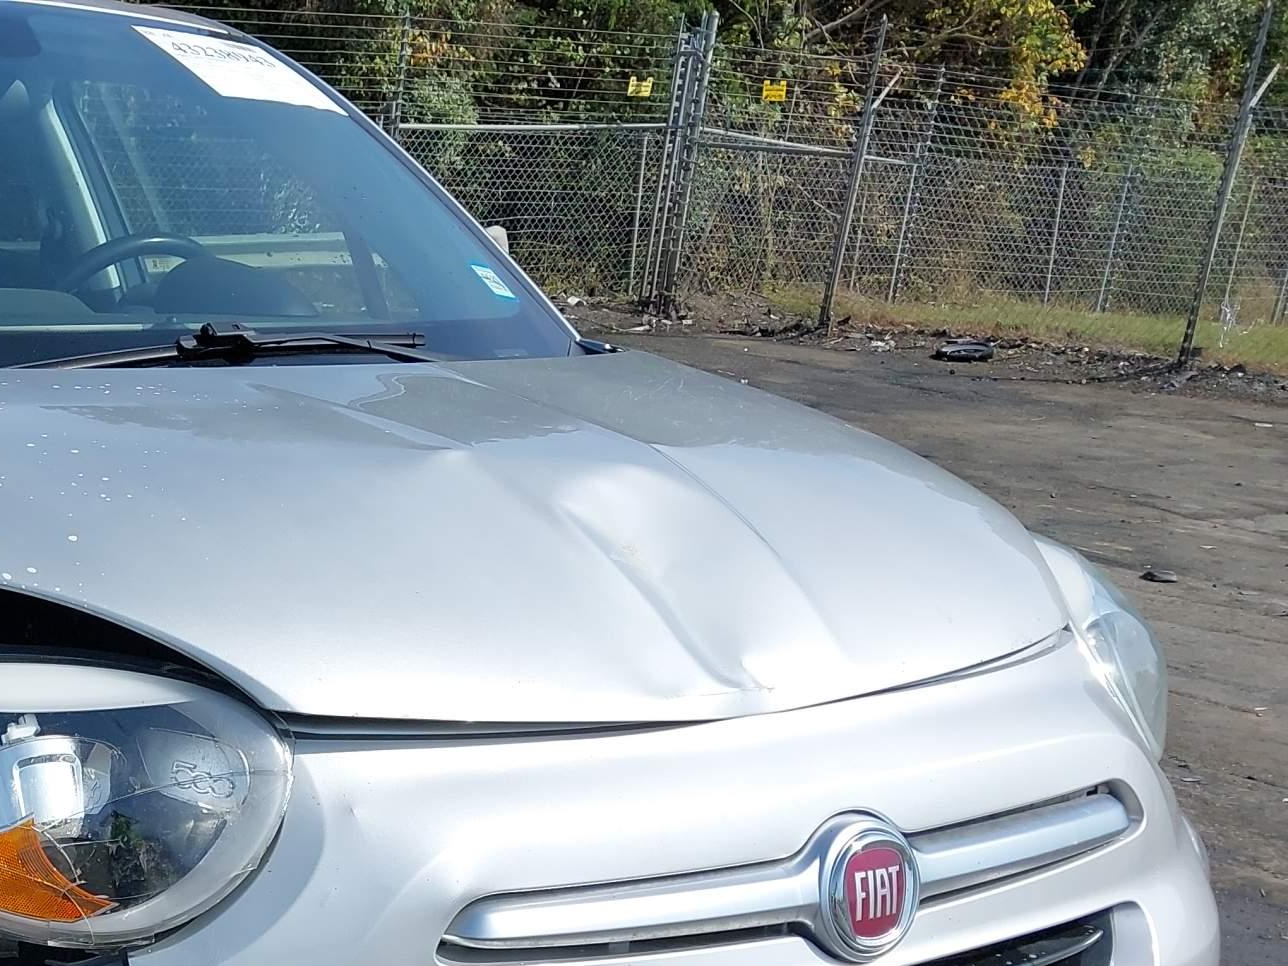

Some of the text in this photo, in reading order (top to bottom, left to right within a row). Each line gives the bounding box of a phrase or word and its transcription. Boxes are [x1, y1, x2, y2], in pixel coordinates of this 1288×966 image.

[171, 41, 276, 68] 43238943
[172, 760, 235, 798] 500
[854, 865, 900, 922] FIAT
